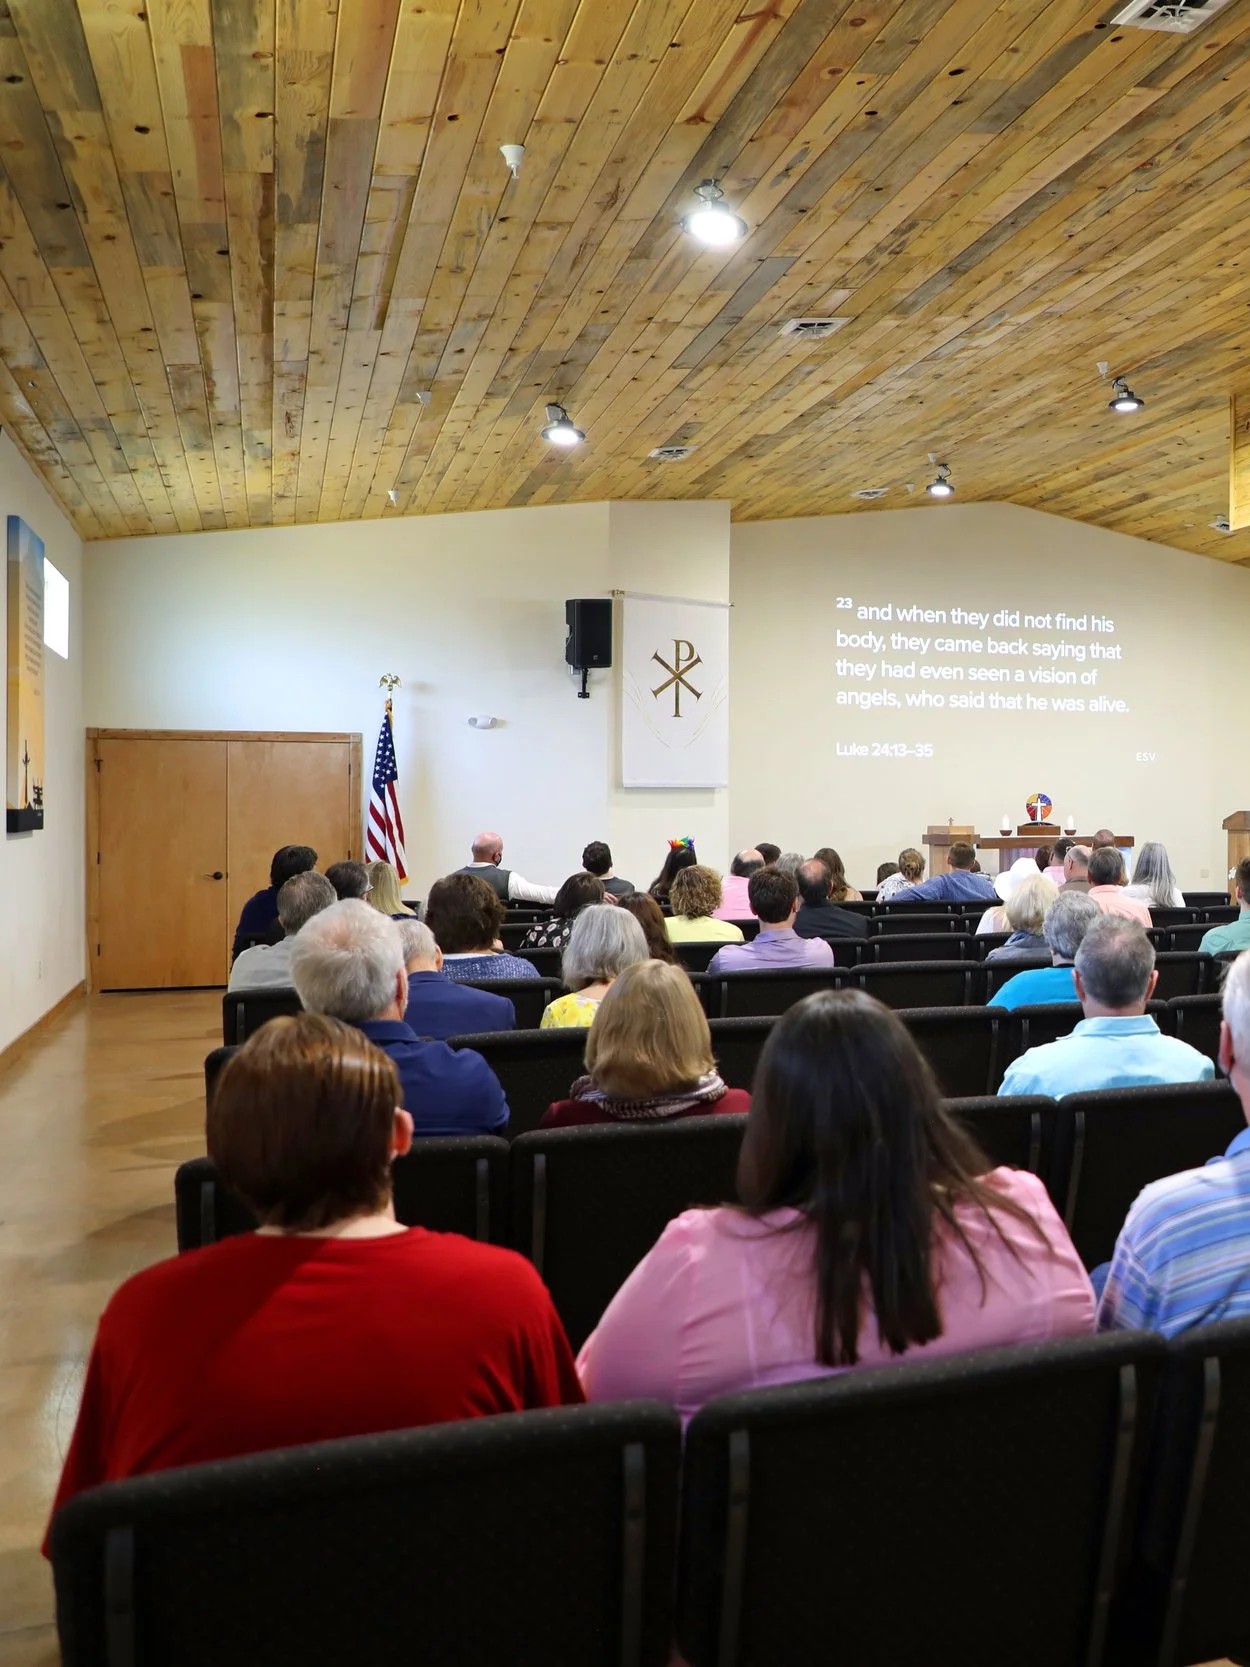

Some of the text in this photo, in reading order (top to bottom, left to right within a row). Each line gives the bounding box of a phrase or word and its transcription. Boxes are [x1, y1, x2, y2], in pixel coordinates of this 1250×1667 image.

[836, 597, 1114, 632] 23 and when they did not find his
[837, 629, 1122, 661] body, they came back saying that
[835, 658, 1098, 685] they had even seen a vision of
[836, 689, 1130, 713] angels, who said that he was alive.
[837, 742, 869, 756] Luke
[1136, 752, 1155, 761] ESV
